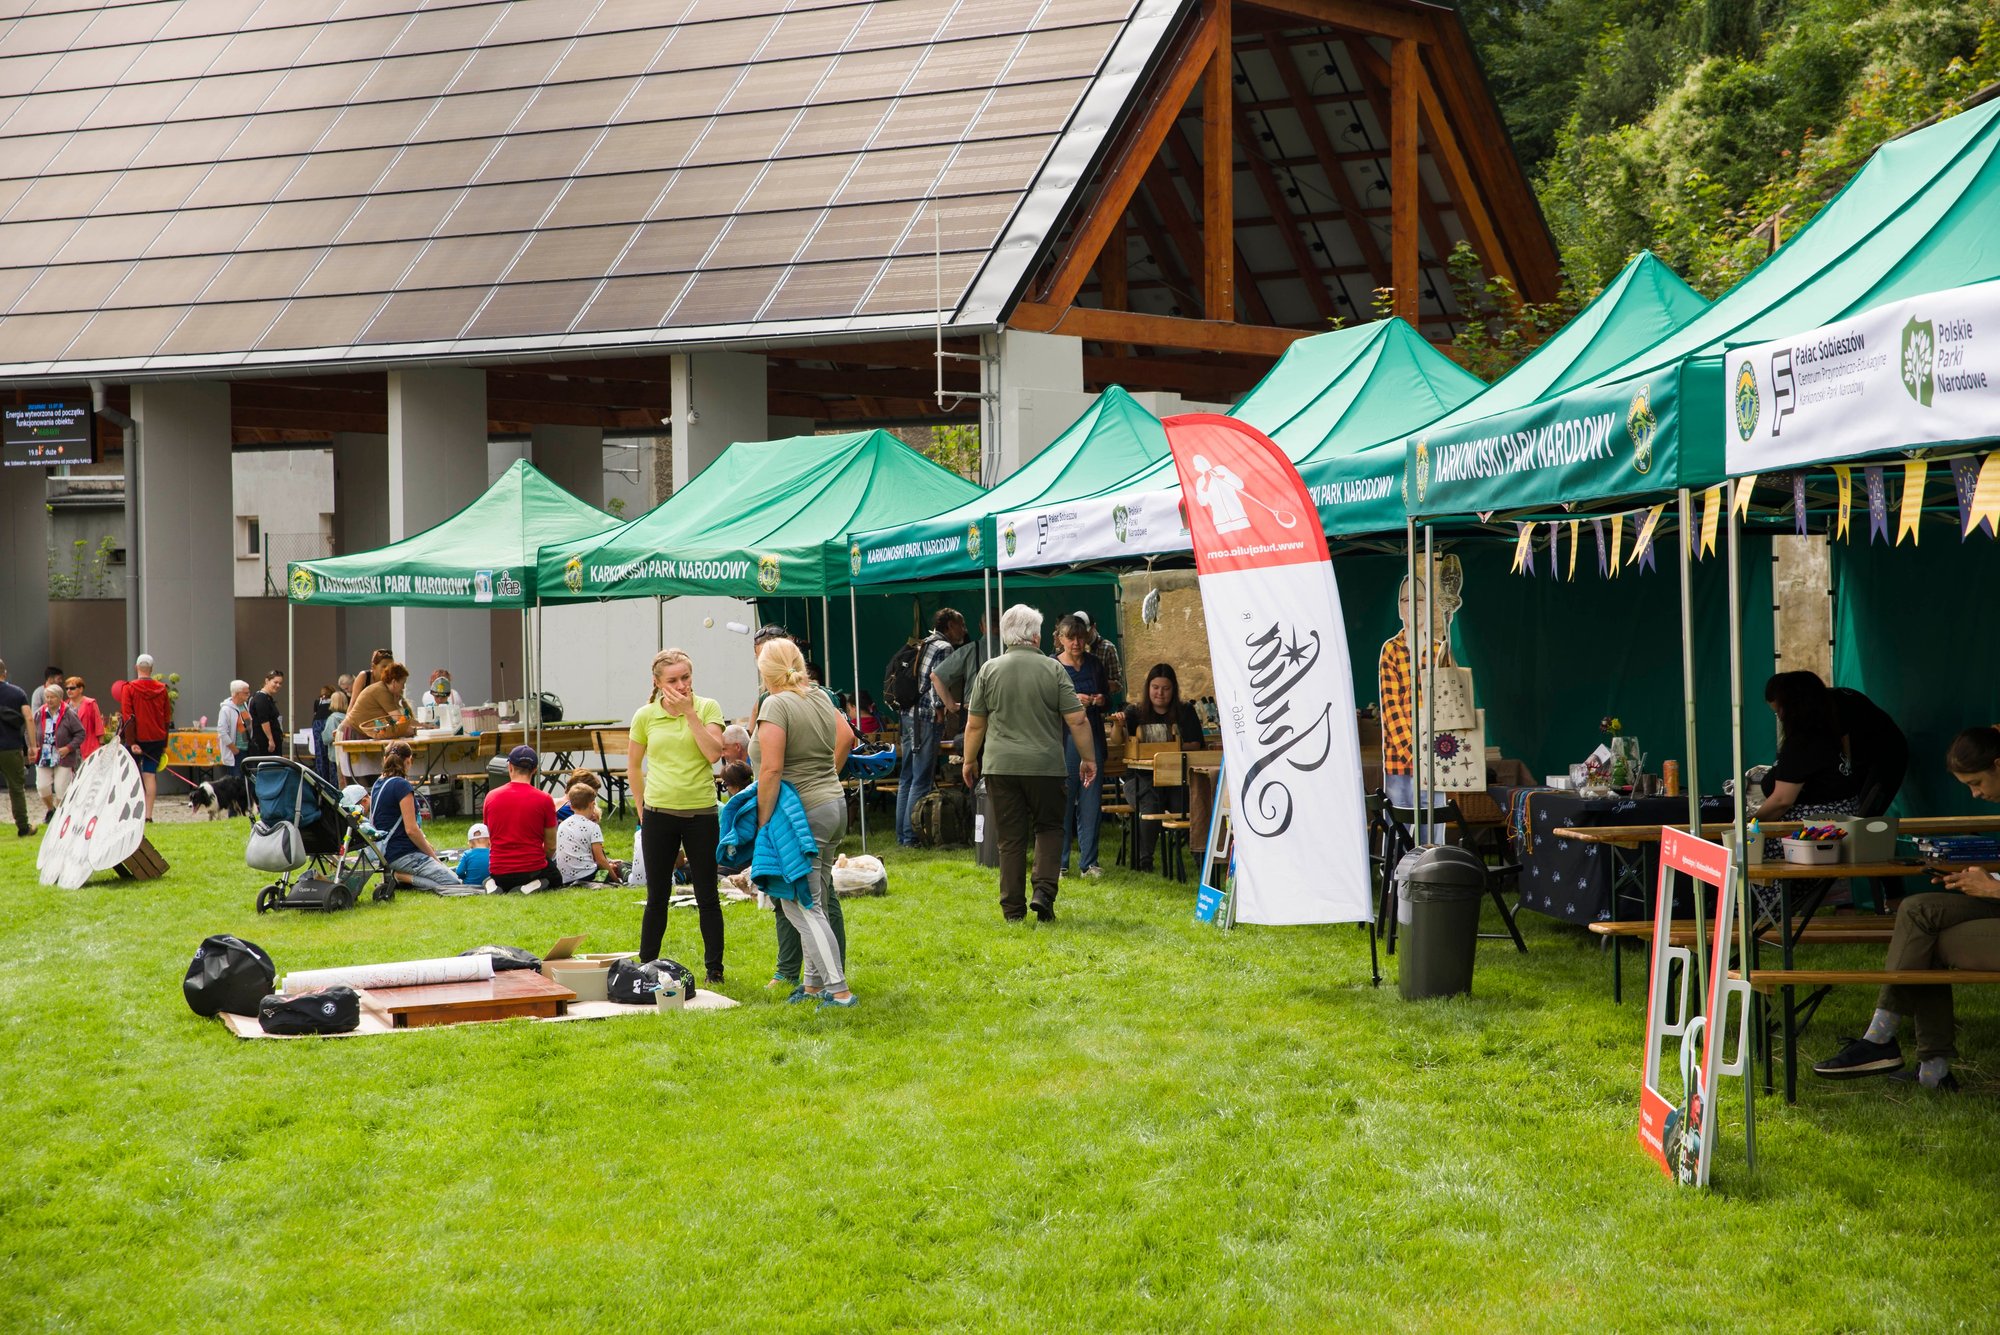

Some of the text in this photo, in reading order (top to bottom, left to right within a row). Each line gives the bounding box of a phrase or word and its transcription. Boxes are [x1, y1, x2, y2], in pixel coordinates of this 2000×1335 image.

[1938, 318, 1973, 344] Polskie
[1795, 331, 1866, 367] Pałac Sobieszów
[1937, 346, 1964, 369] Parki
[1937, 370, 1988, 394] Narodowe
[5, 410, 24, 419] Energia
[1434, 412, 1617, 484] KARKONOSKI PARK NARODOWY
[1320, 482, 1343, 506] PARK
[1343, 475, 1395, 503] NARODOWY
[866, 535, 961, 565] KARKONOSKI PARK NARODOWY
[648, 560, 677, 579] PARK
[678, 560, 751, 580] NARODOWY
[318, 575, 471, 595] KARKONOSKI PARK NARODOWY
